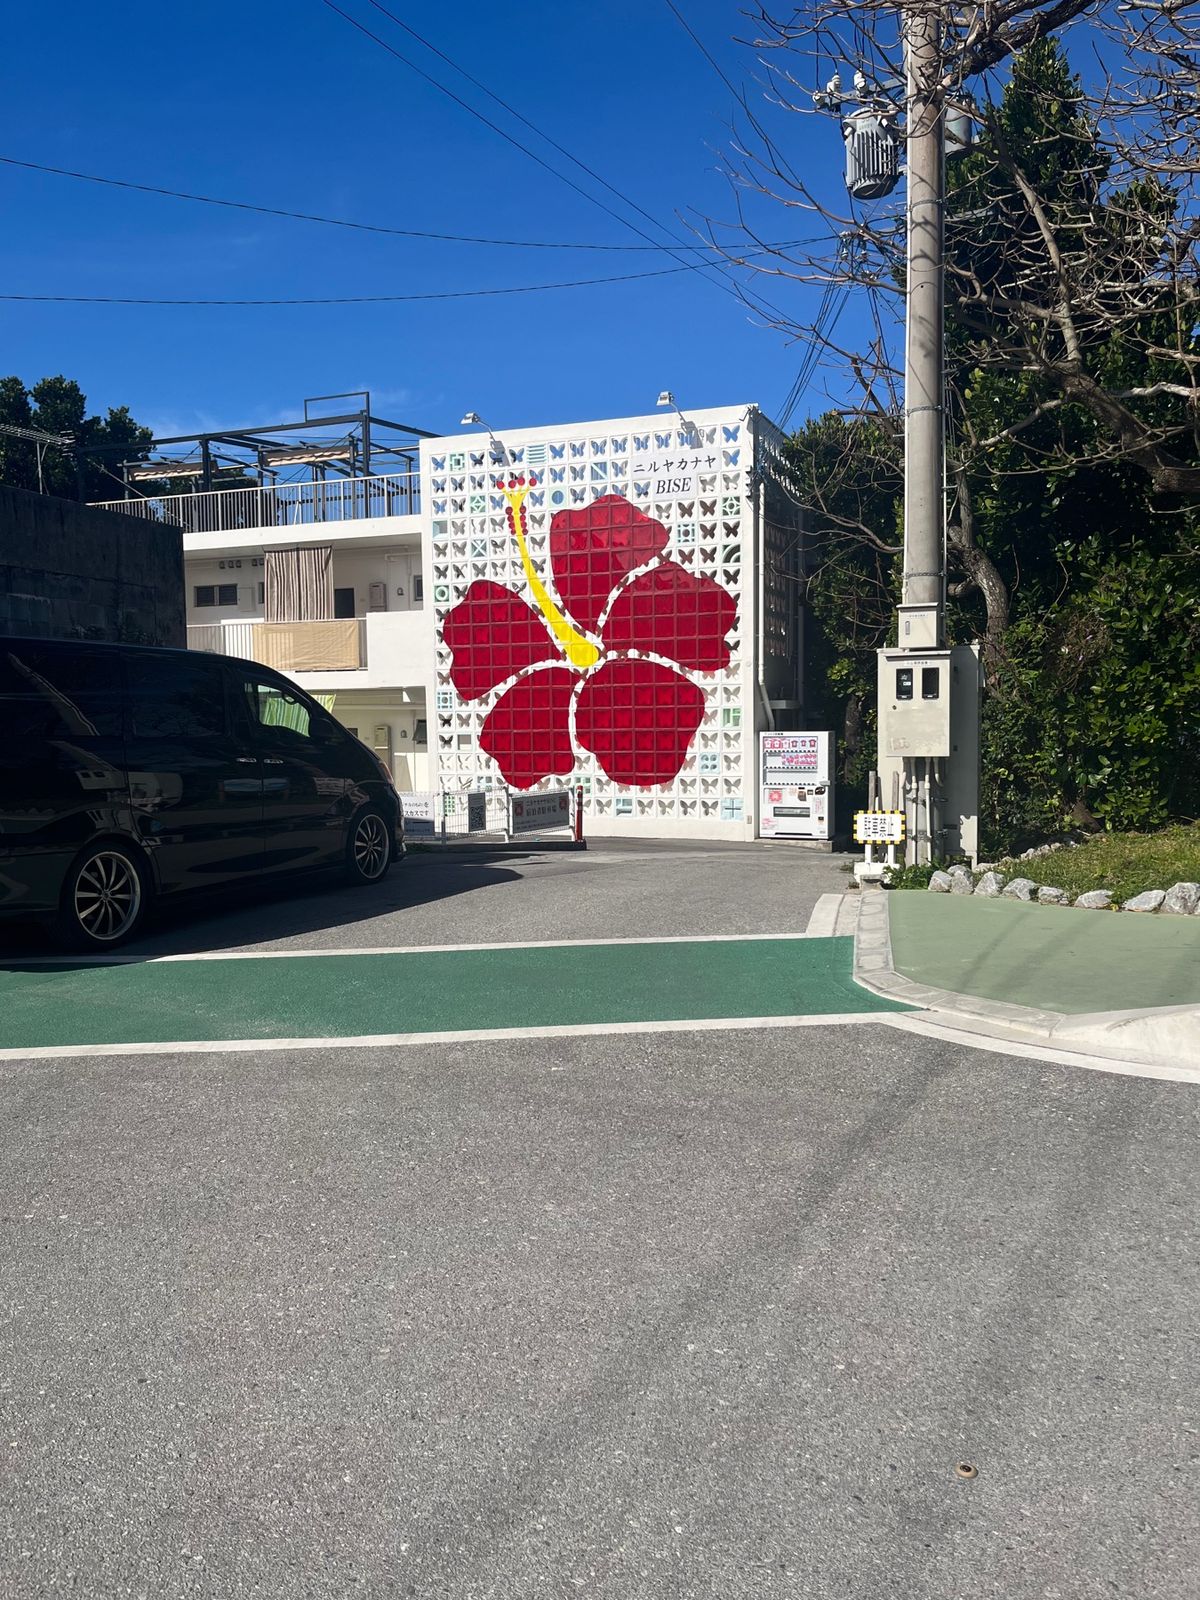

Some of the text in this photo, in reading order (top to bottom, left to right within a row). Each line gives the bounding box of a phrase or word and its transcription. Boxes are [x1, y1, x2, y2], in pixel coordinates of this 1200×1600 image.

[633, 455, 716, 472] ニルヤカナヤ
[656, 477, 692, 494] BISE
[864, 816, 895, 838] 駐車禁止
